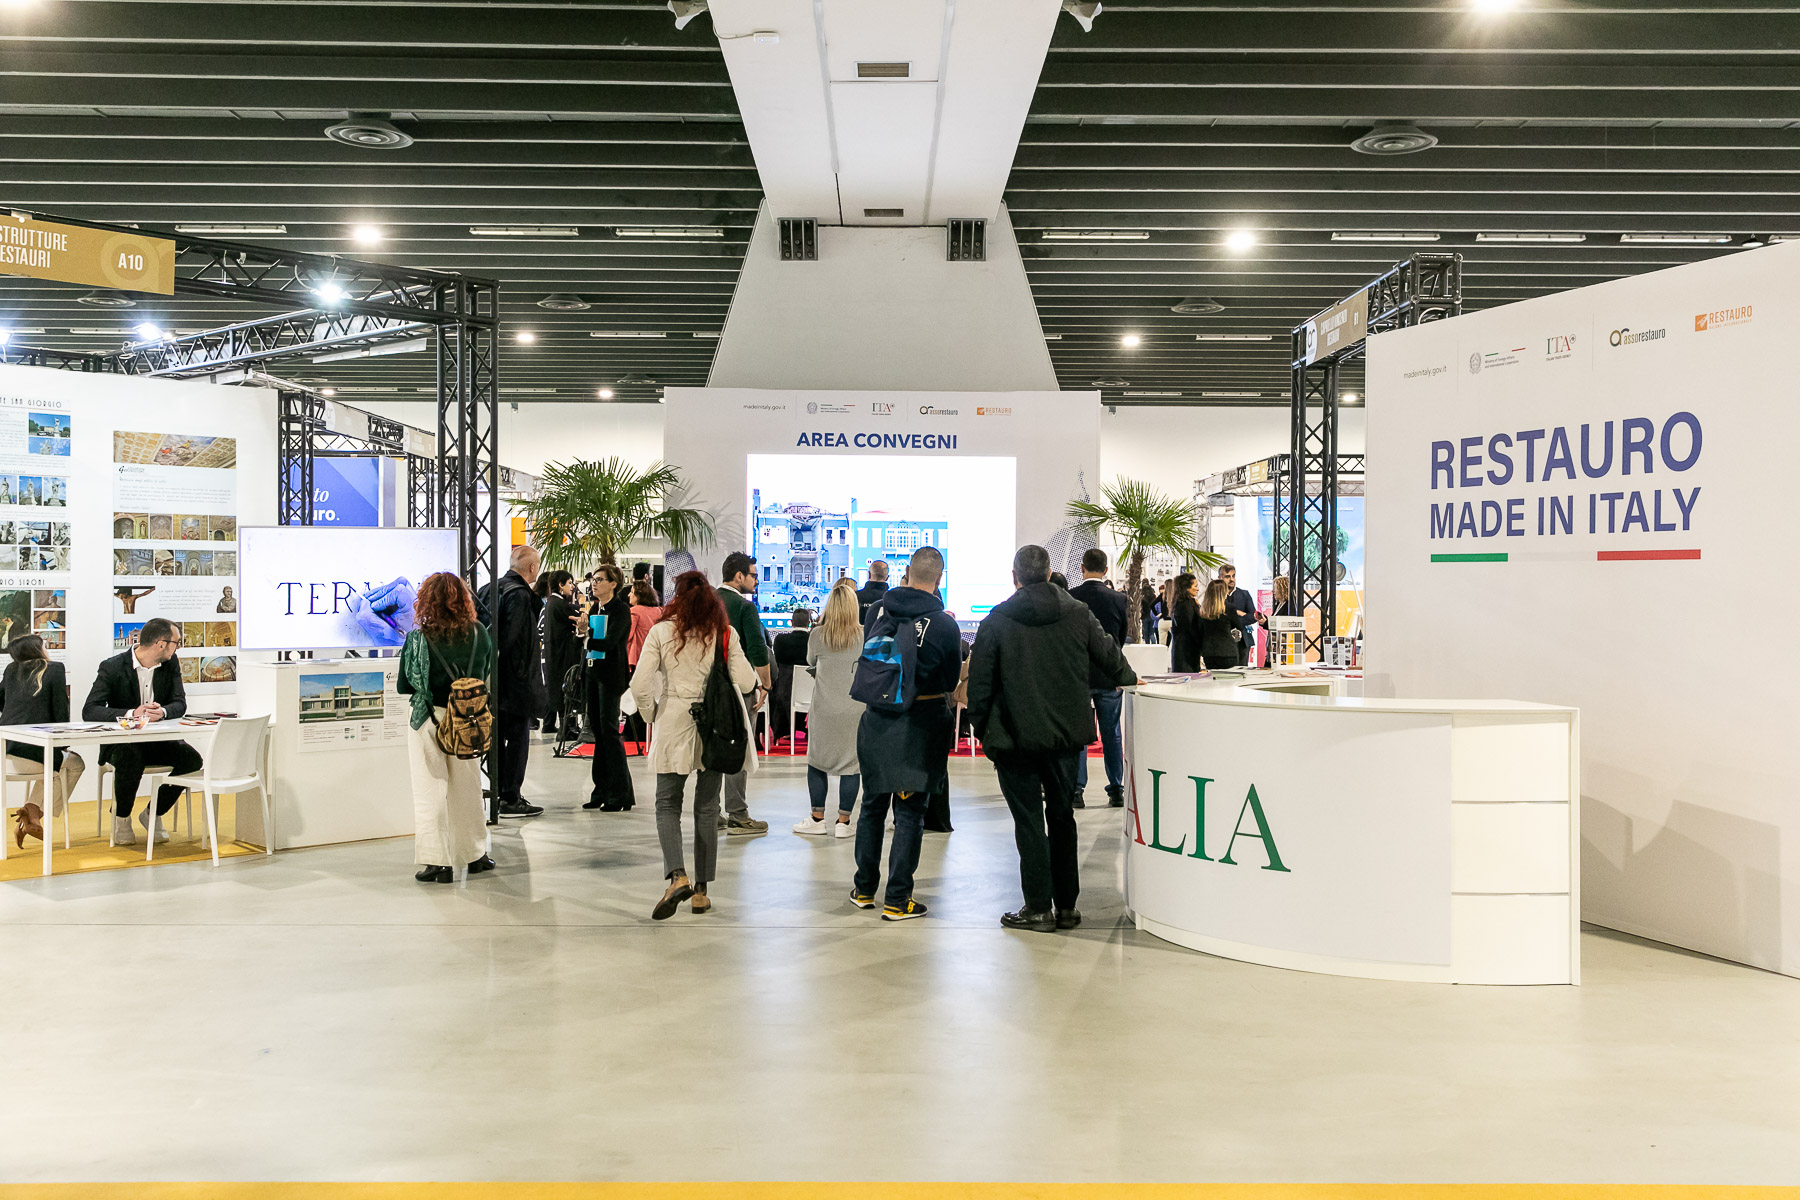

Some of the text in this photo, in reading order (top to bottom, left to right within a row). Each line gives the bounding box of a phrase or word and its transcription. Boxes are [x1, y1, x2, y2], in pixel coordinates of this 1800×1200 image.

[117, 253, 144, 271] A10
[1709, 305, 1753, 324] RESTAURO
[1546, 335, 1571, 355] ITA
[1624, 328, 1666, 345] assorestauro
[1403, 365, 1447, 379] madeinitaly.gov.it
[28, 399, 62, 408] GIORGIO
[929, 408, 958, 416] assorestauro
[796, 432, 957, 449] AREA CONVEGNI
[1431, 411, 1703, 490] RESTAURO
[1430, 486, 1702, 539] MADE IN ITALY
[19, 578, 45, 586] SIRONI
[1124, 758, 1291, 873] ALIA
